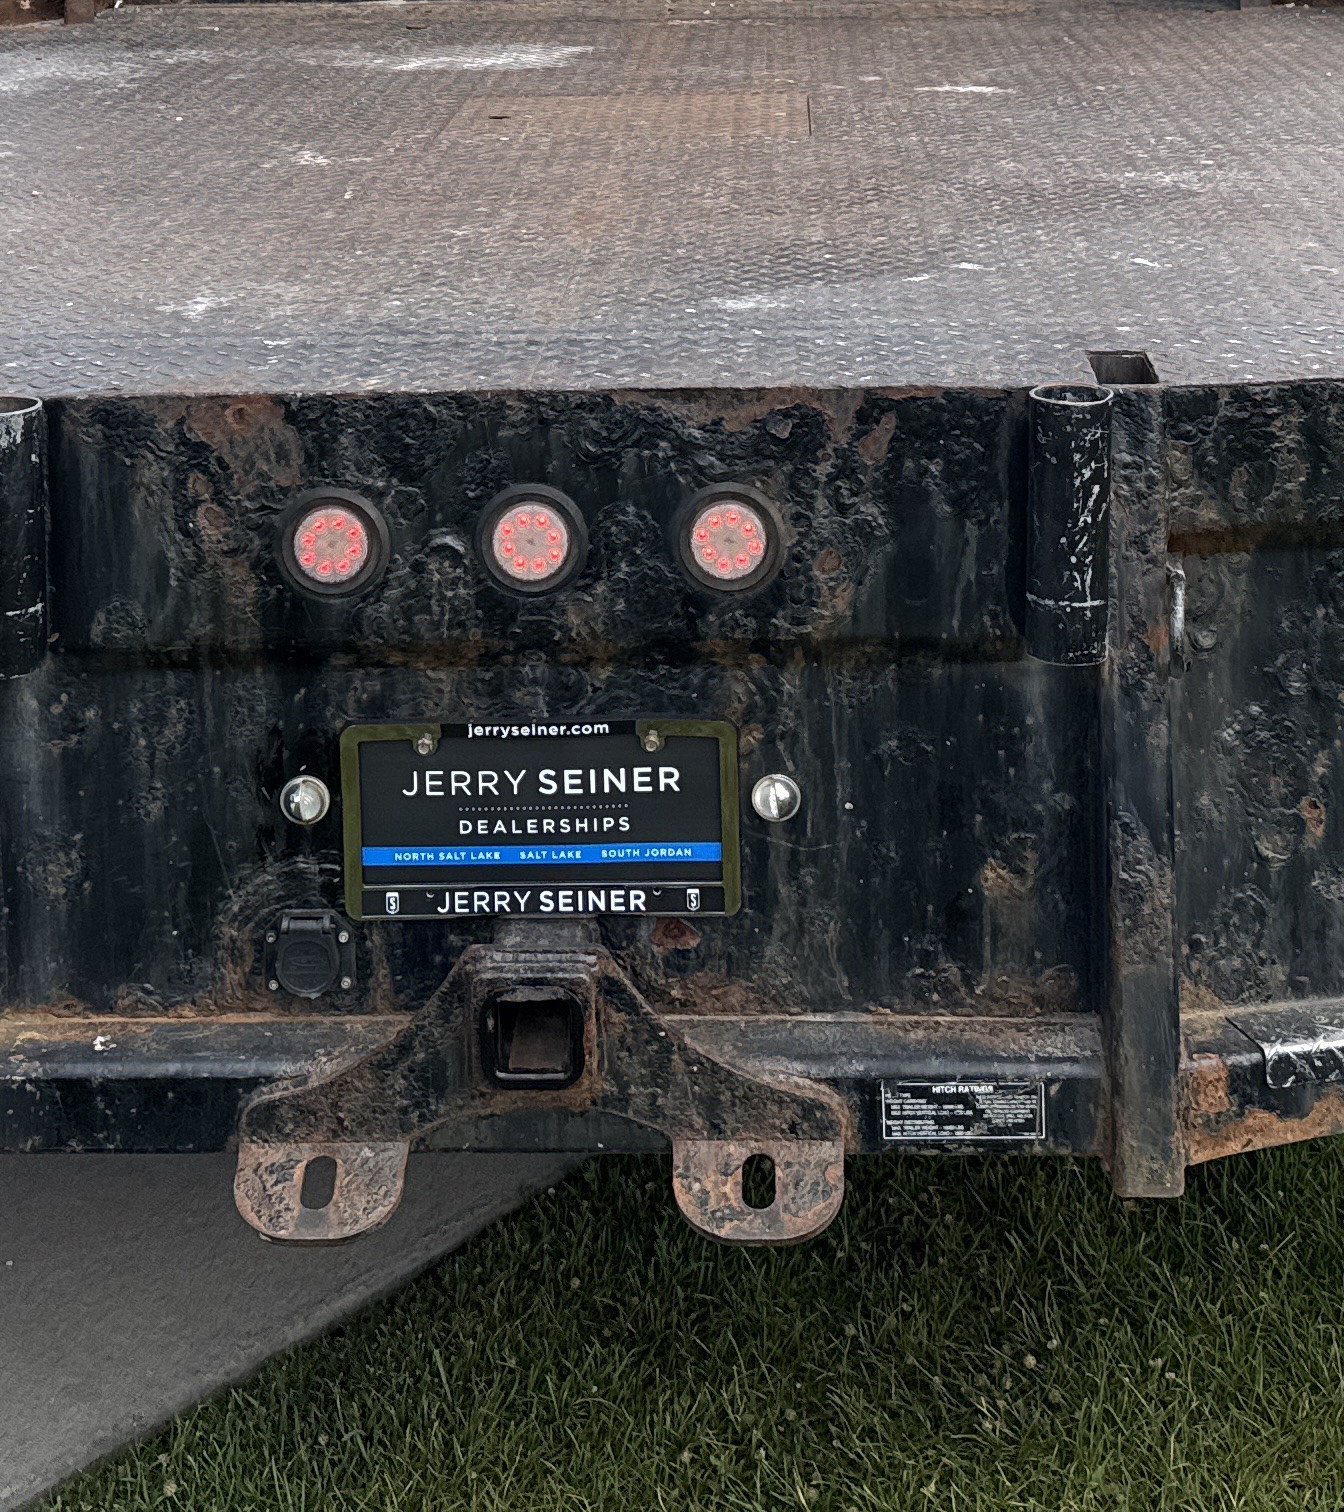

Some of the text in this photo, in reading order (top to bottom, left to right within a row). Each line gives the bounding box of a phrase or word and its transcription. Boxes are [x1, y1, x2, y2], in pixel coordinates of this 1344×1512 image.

[467, 723, 610, 739] jerryseiner.com
[402, 766, 681, 797] JERRY SEINER
[459, 816, 631, 835] DEALERSHIPS
[394, 847, 693, 861] NORTH SALT LAKE SALT LAKE SOUTH JORDAN
[436, 889, 646, 914] JERRY SEINER
[932, 1085, 956, 1093] HITCH
